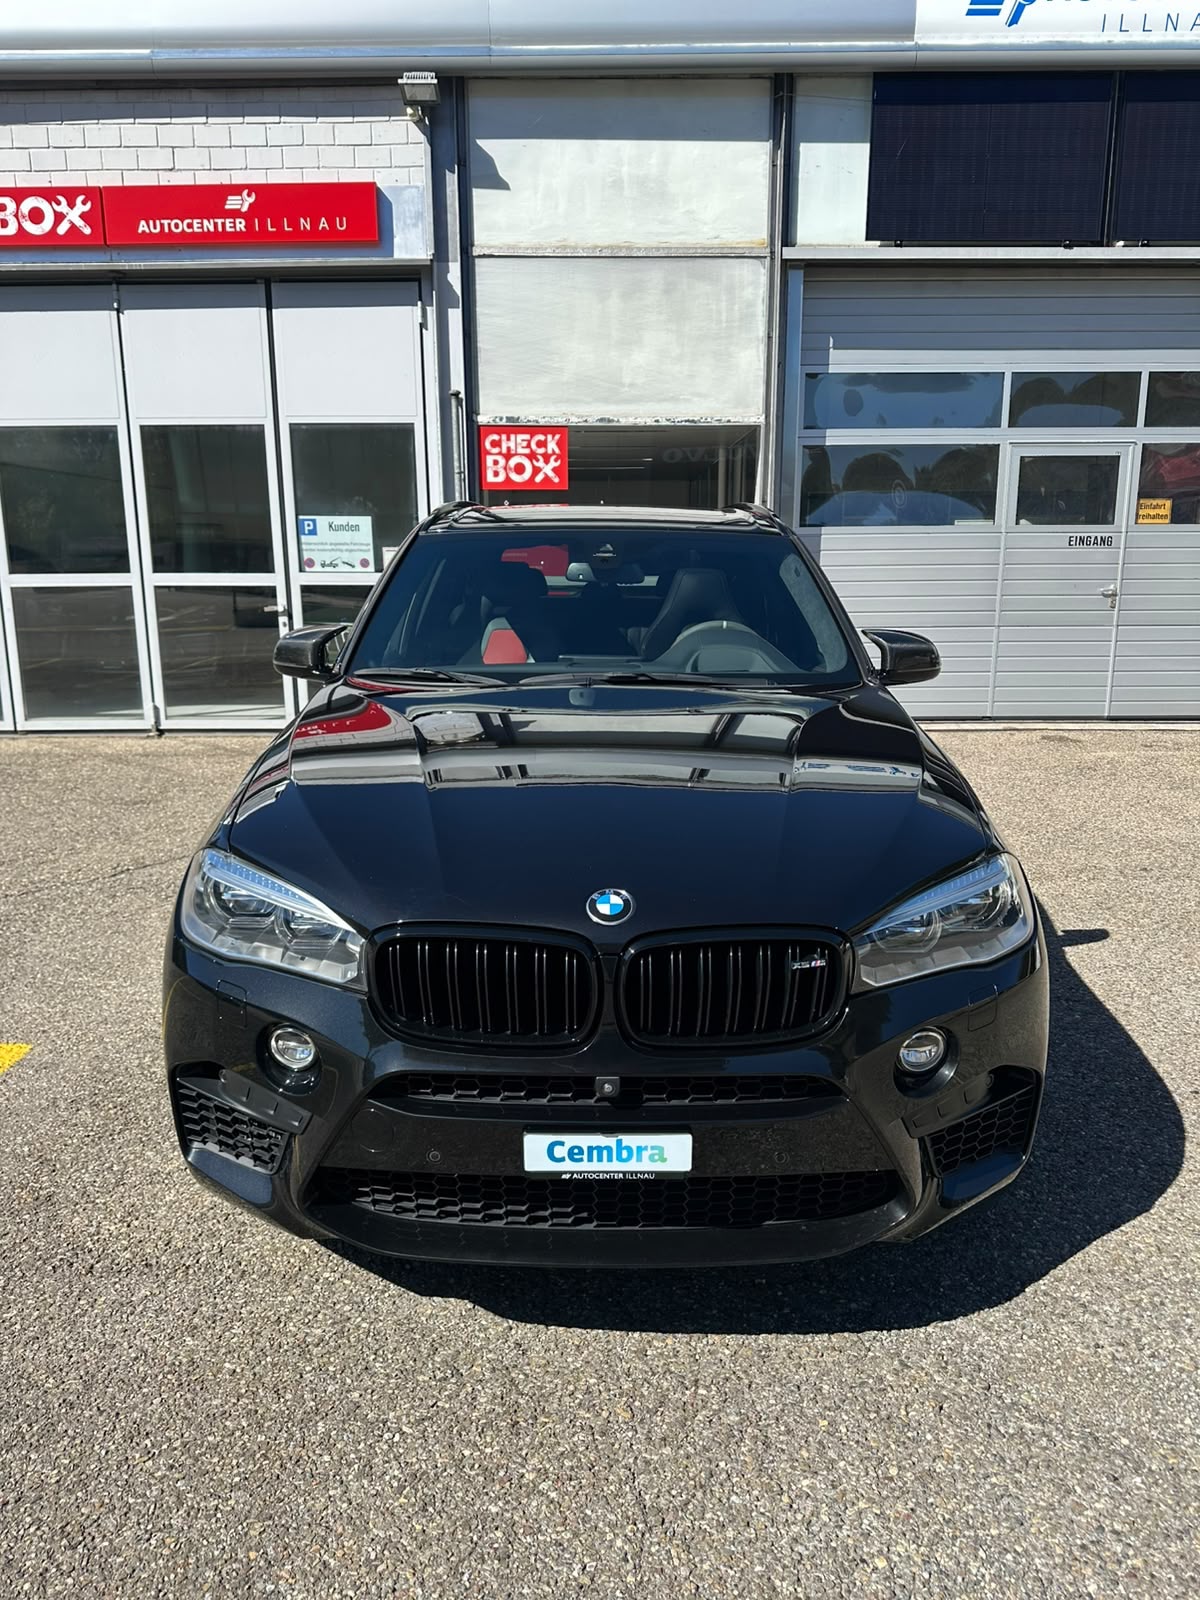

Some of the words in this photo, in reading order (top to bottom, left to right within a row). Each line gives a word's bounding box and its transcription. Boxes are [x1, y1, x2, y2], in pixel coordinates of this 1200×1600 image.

[0, 194, 92, 236] BOX
[137, 217, 246, 234] AUTOCENTER
[254, 216, 348, 232] ILLNAU
[484, 433, 561, 455] CHECK
[485, 454, 561, 484] BOX
[1139, 502, 1166, 510] Einfahrt
[1138, 512, 1169, 520] reihalten
[303, 520, 314, 535] P
[328, 521, 360, 532] Kunden
[1068, 535, 1113, 547] EINGANG
[546, 1138, 668, 1163] Cembra
[572, 1172, 624, 1180] AUTOCENTER
[625, 1172, 656, 1180] ILLNAU
